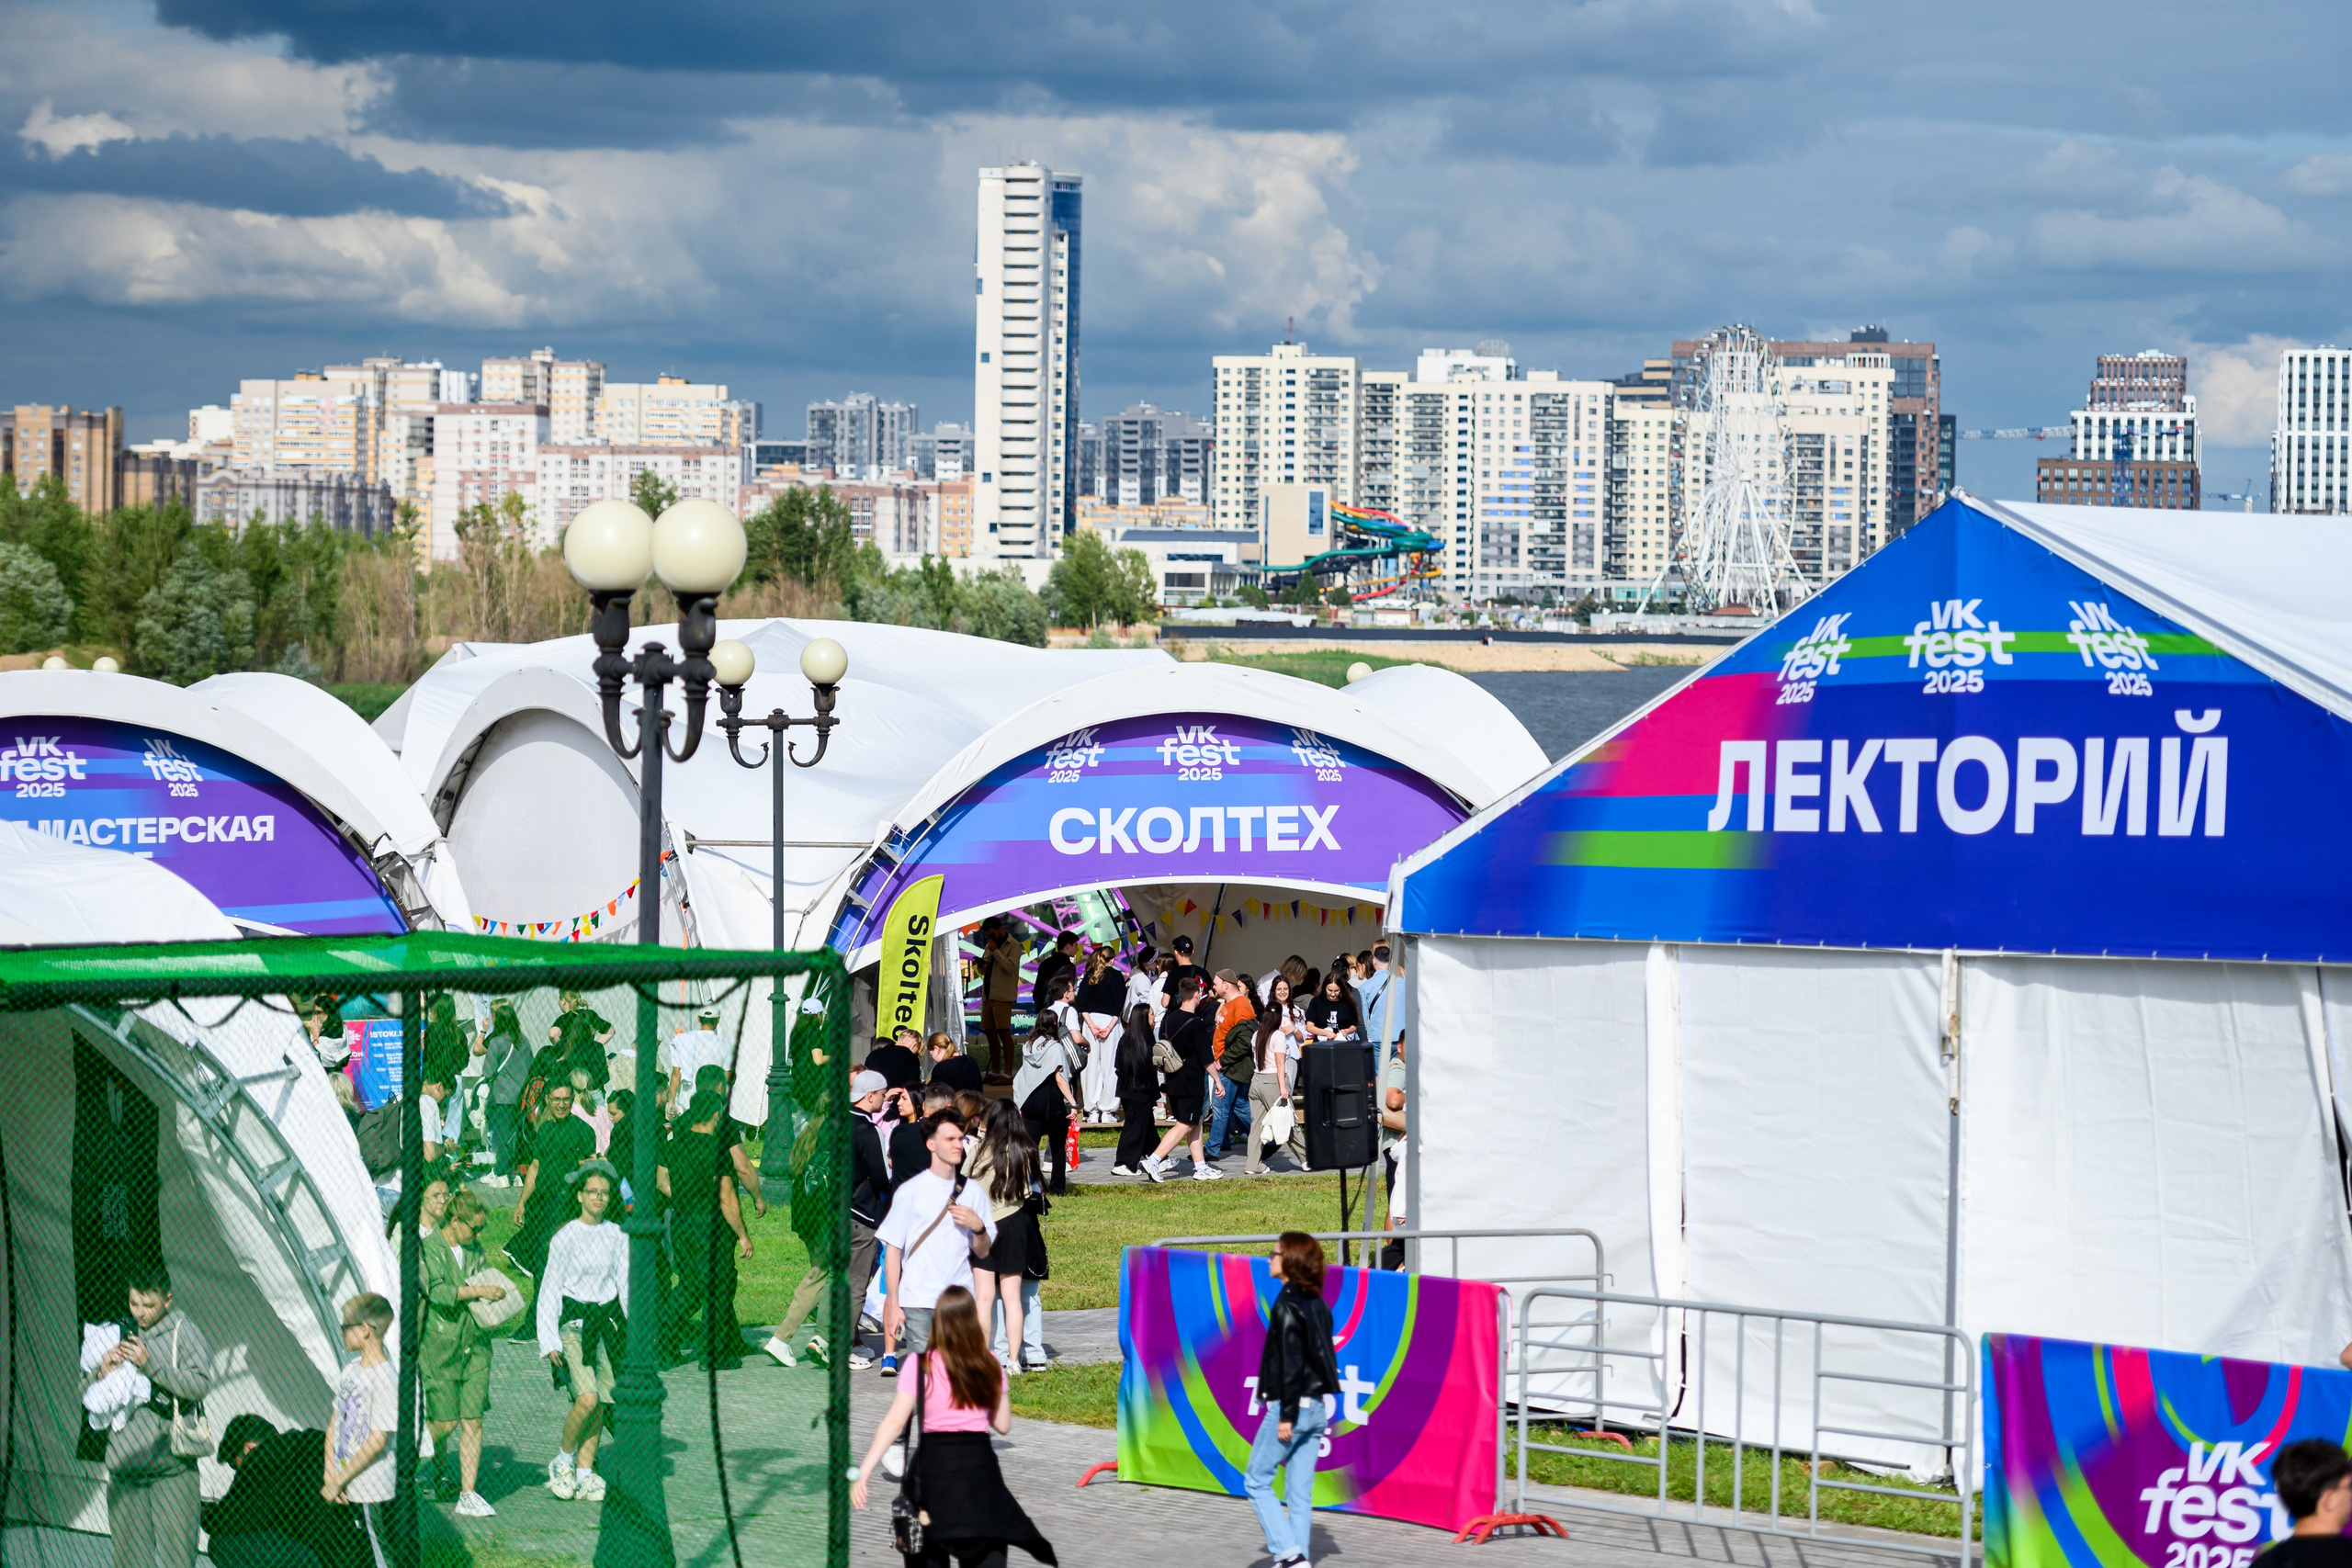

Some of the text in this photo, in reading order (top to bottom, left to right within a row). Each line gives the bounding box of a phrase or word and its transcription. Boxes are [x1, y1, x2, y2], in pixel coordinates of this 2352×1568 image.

[1931, 599, 1985, 630] VK
[2068, 601, 2126, 632] VK
[1807, 613, 1852, 645] VK
[1777, 634, 1852, 682] fest
[1903, 621, 2016, 669] fest
[2066, 620, 2159, 670] fest
[1776, 681, 1817, 705] 2025
[1923, 669, 1984, 694] 2025
[2105, 671, 2153, 696] 2025
[15, 736, 63, 757] VK
[1066, 728, 1100, 747] VK
[1176, 726, 1221, 744] VK
[1291, 728, 1325, 747] VK
[143, 739, 182, 759] VK
[1044, 742, 1106, 769] fest
[1156, 738, 1240, 766] fest
[1291, 739, 1346, 768] fest
[0, 750, 86, 782] fest
[142, 750, 204, 782] fest
[1047, 770, 1081, 783] 2025
[1178, 767, 1223, 781] 2025
[1315, 768, 1342, 782] 2025
[1707, 708, 2229, 837] ЛЕКТОРИЙ
[16, 783, 65, 798] 2025
[168, 783, 199, 797] 2025
[38, 815, 275, 845] МАСТЕРСКАЯ
[1048, 805, 1342, 855] СКОЛТЕХ
[2188, 1441, 2272, 1485] VK
